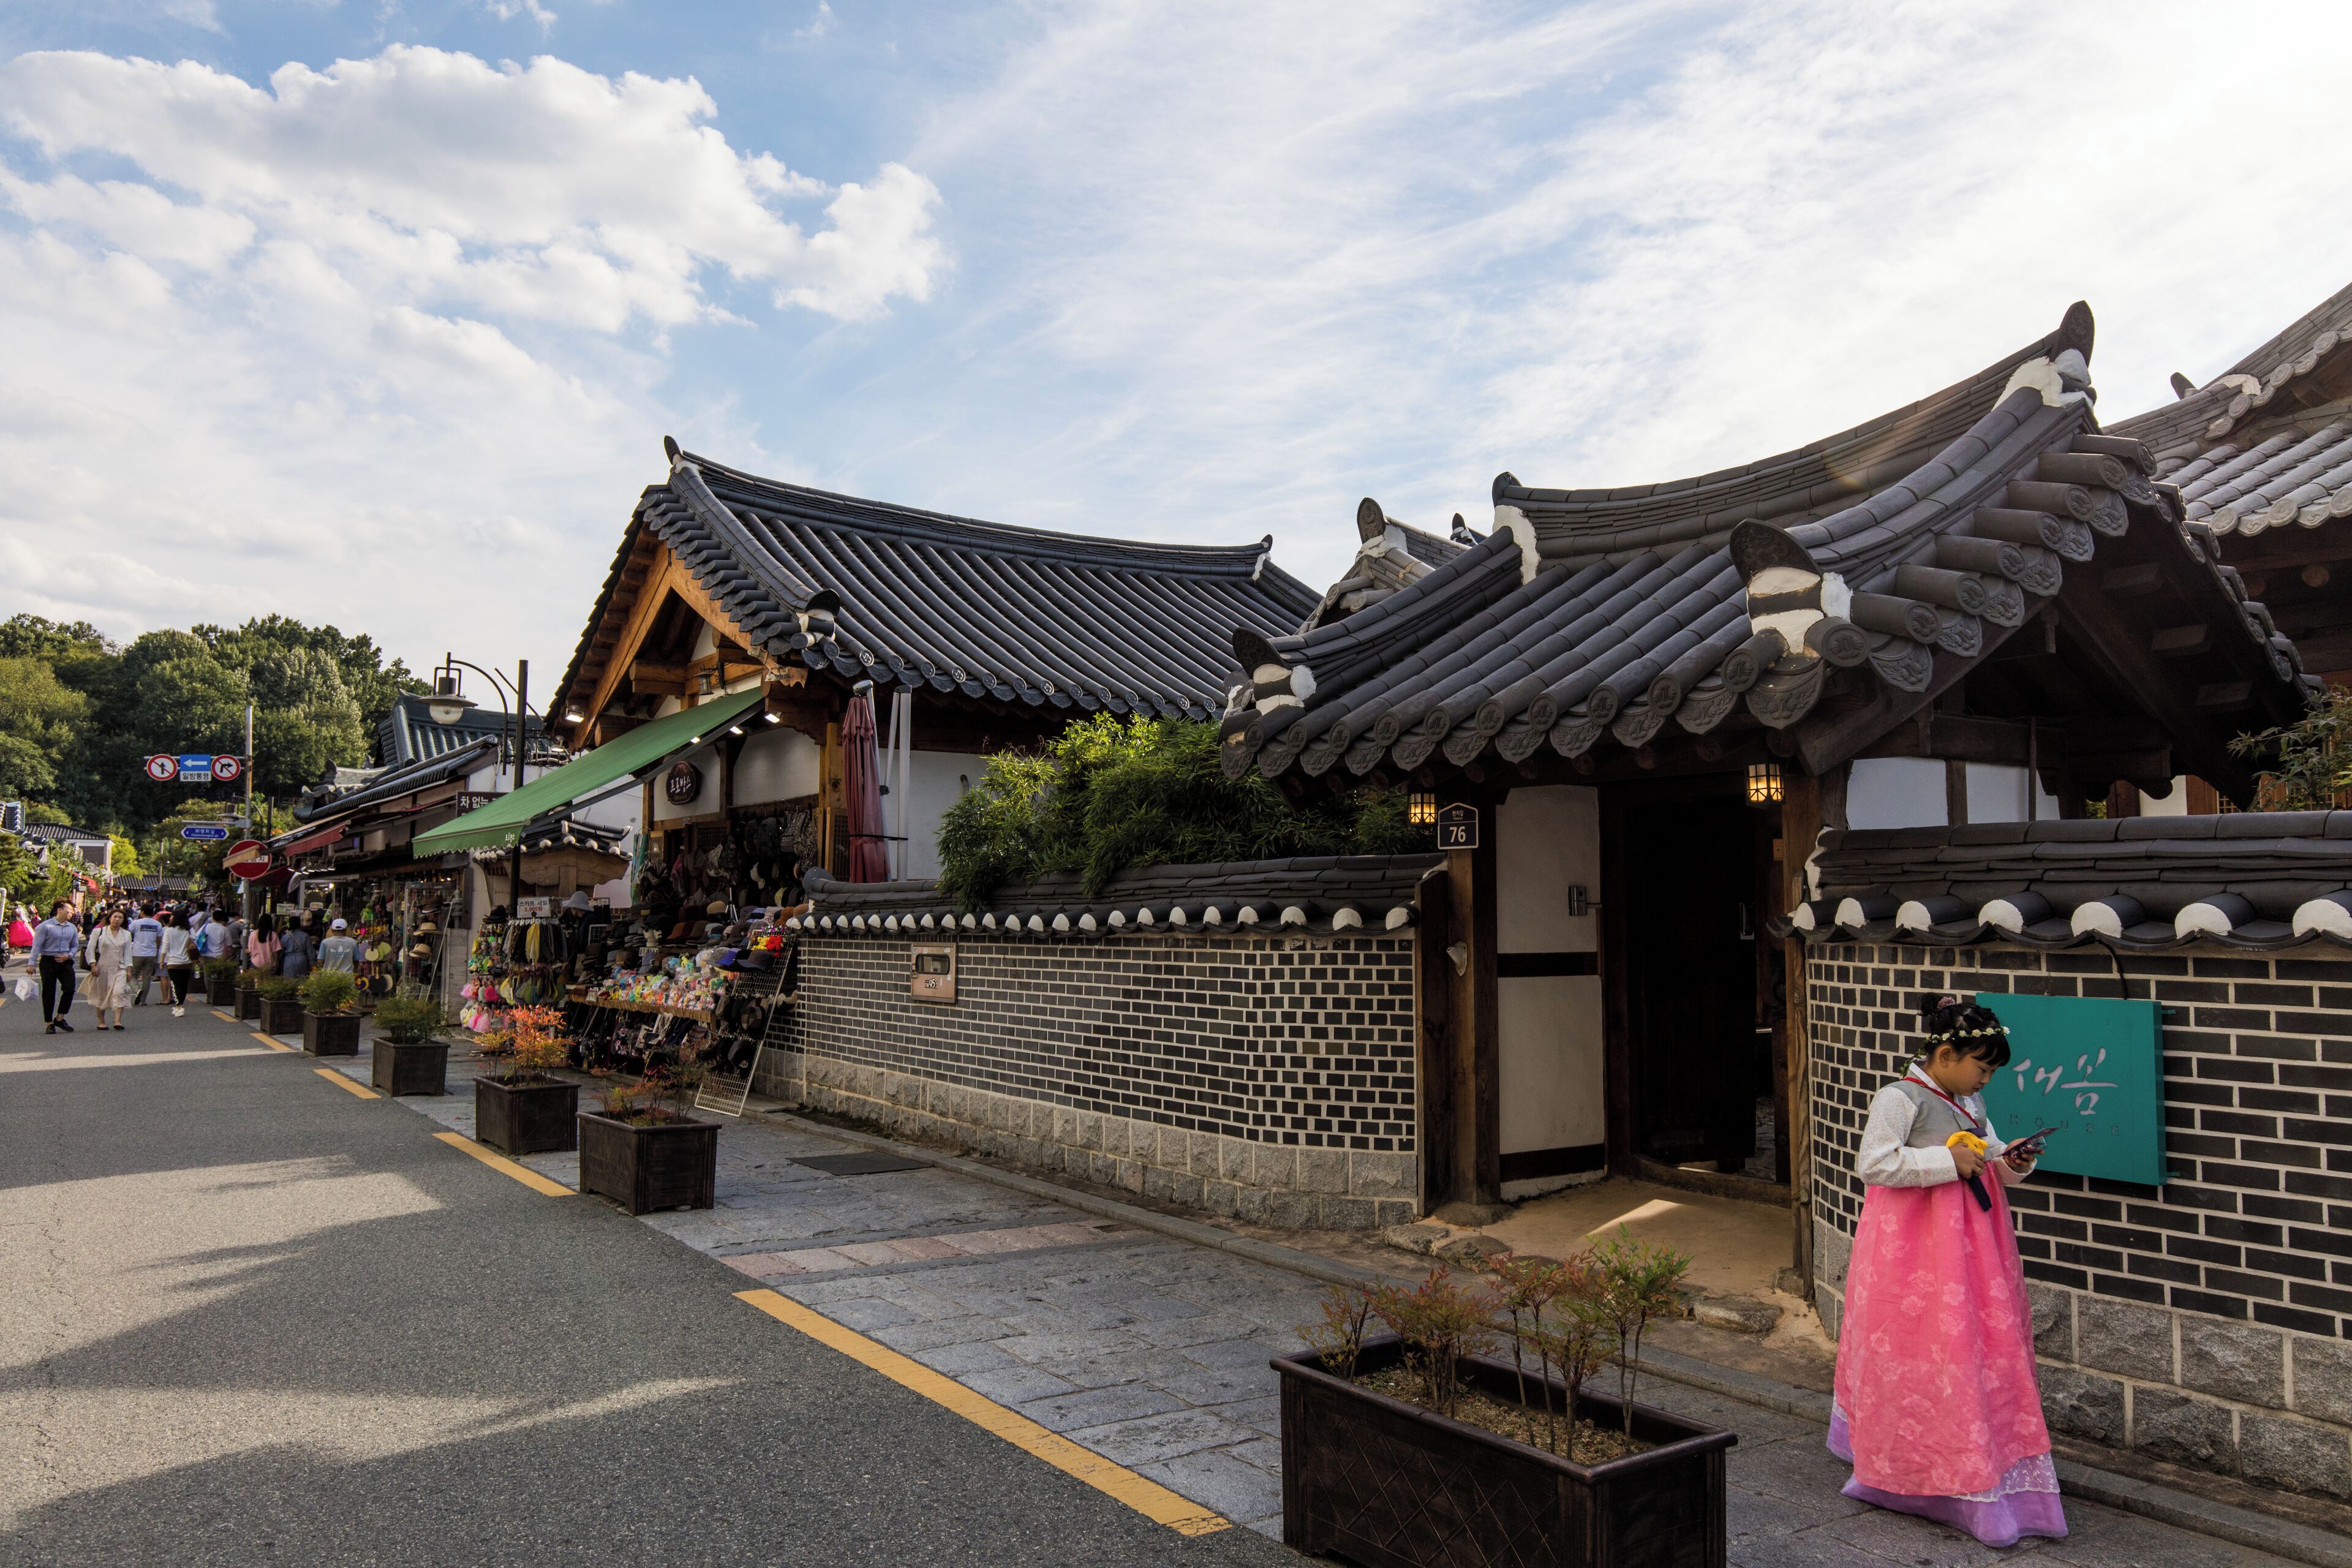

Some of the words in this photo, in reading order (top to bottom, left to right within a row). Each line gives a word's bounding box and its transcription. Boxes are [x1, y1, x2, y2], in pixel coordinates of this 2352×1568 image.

[670, 775, 691, 793] 프로방스
[461, 796, 469, 808] 차
[472, 796, 489, 809] 없는
[1449, 826, 1466, 842] 76
[2010, 1114, 2120, 1137] HOUSE
